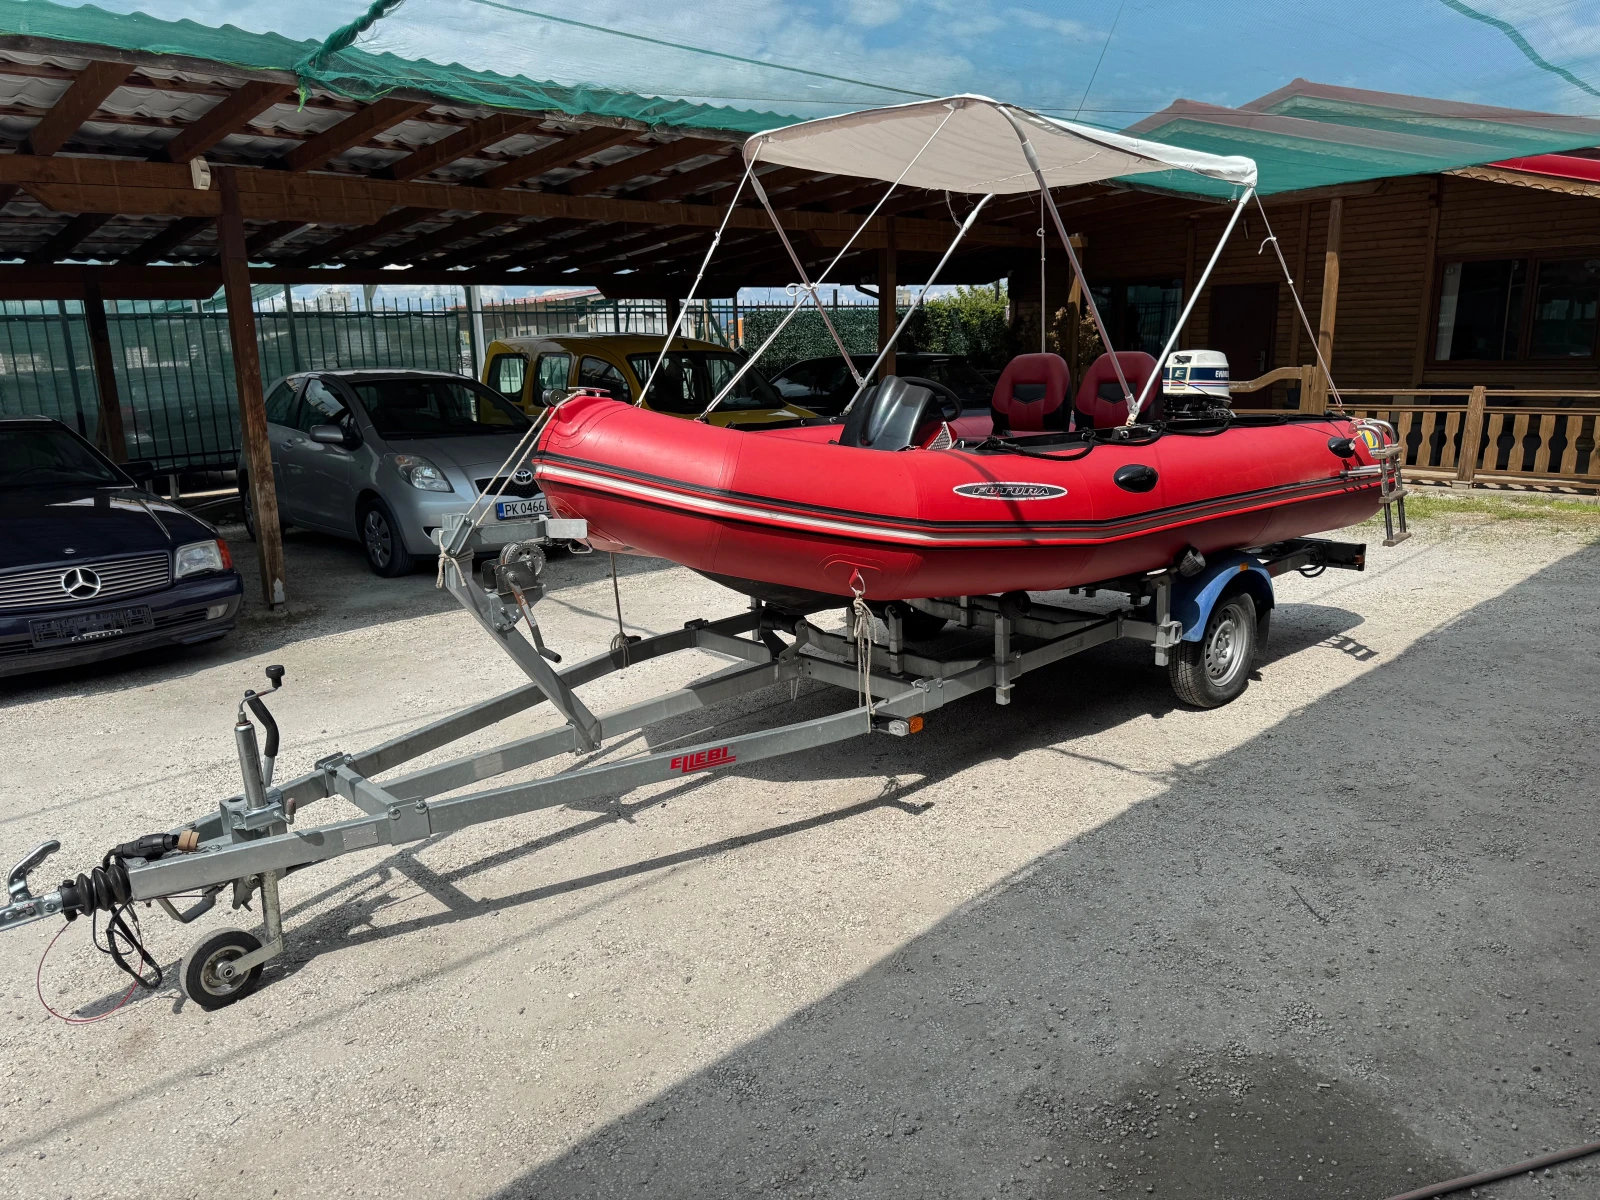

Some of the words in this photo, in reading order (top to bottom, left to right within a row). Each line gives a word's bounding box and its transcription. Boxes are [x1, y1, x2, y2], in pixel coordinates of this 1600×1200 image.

[972, 486, 1050, 496] FUTURA
[505, 503, 519, 516] PK
[520, 501, 545, 514] 0466
[670, 746, 737, 774] ELLEBI
